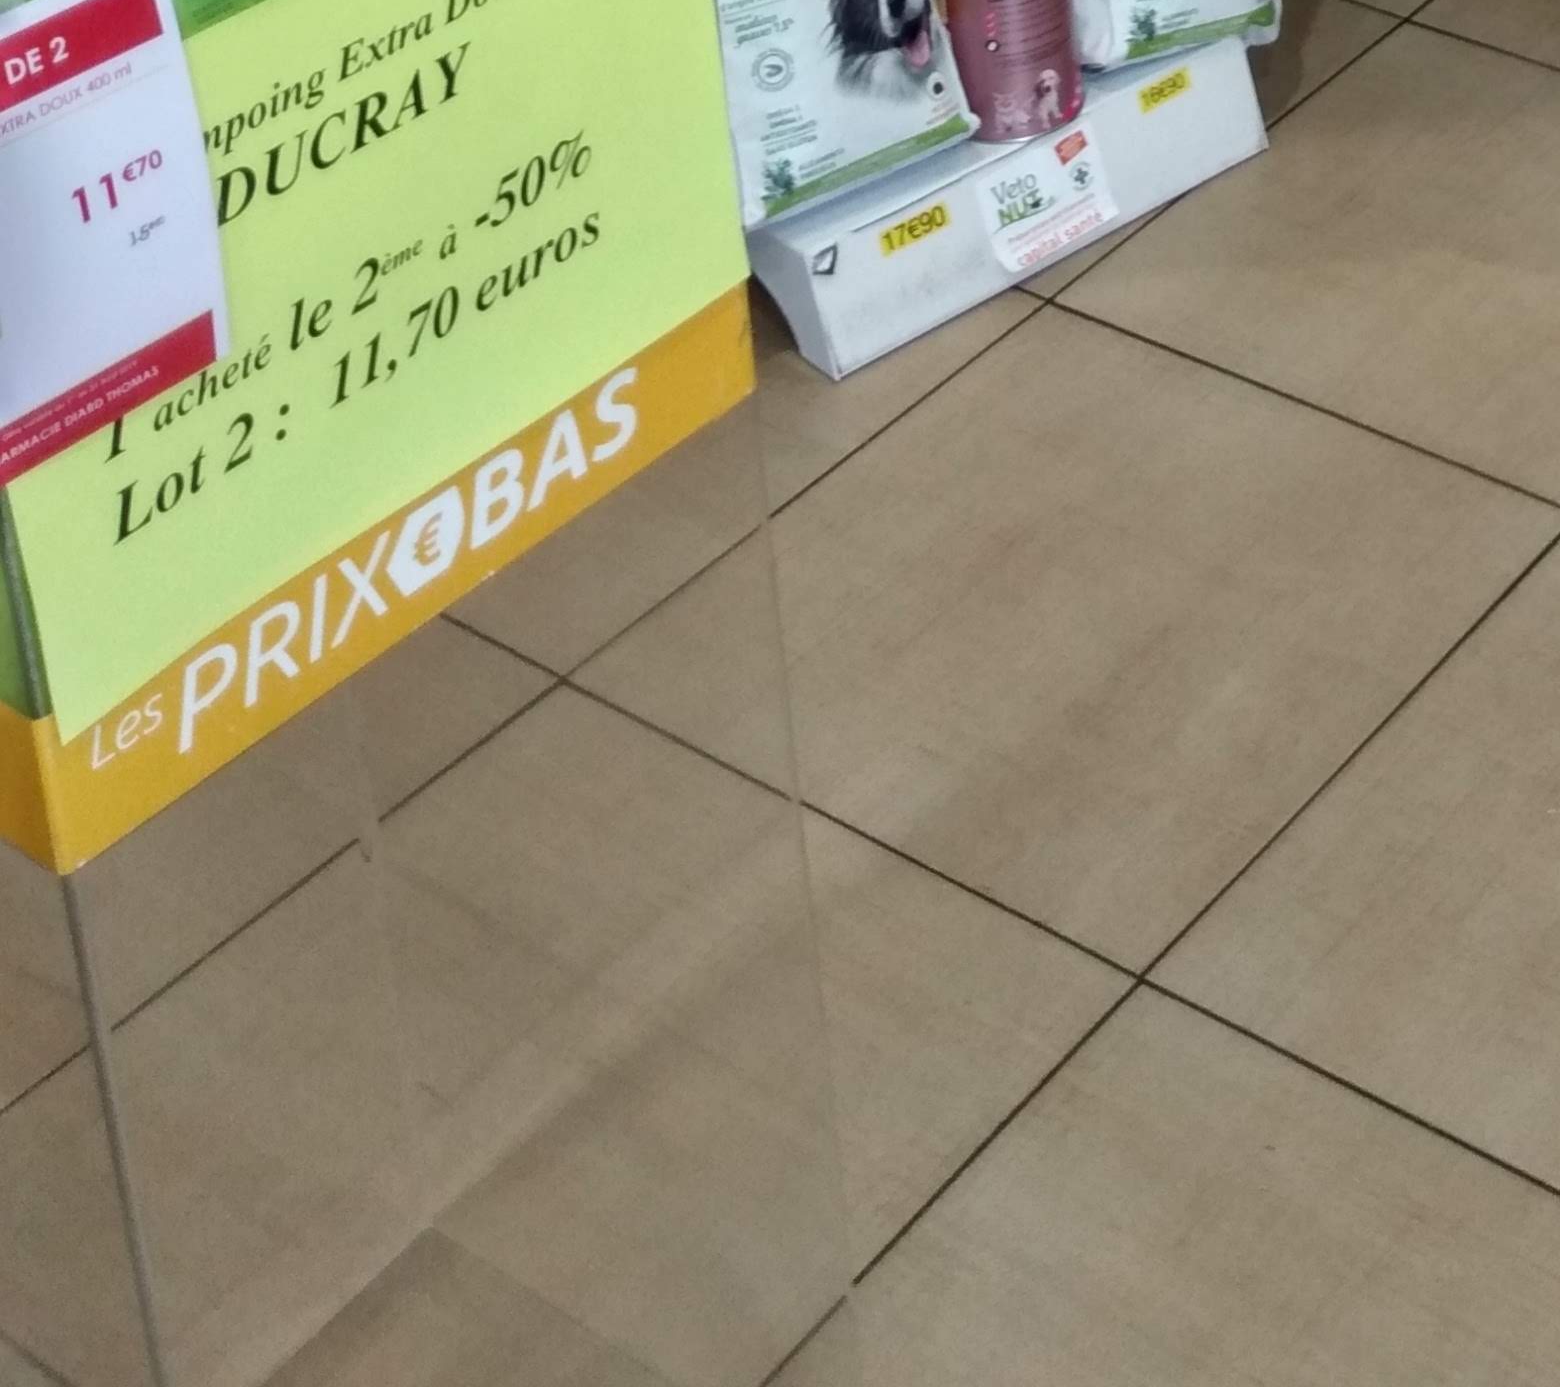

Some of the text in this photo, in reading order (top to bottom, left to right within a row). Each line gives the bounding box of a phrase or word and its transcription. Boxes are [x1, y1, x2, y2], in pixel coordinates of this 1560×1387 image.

[5, 38, 69, 85] DE 2
[338, 16, 432, 85] Extra
[40, 87, 84, 116] DOUX
[216, 43, 472, 226] DUCRAY
[72, 149, 162, 224] 11€70
[882, 209, 947, 251] 17€90
[153, 336, 272, 433] acheté
[289, 297, 332, 351] le
[438, 224, 459, 261] à
[474, 135, 592, 230] -50%
[105, 365, 160, 405] THOMAS
[114, 211, 601, 546] Lot 2 11,70 euros
[89, 368, 638, 771] Les PRIX BAS
